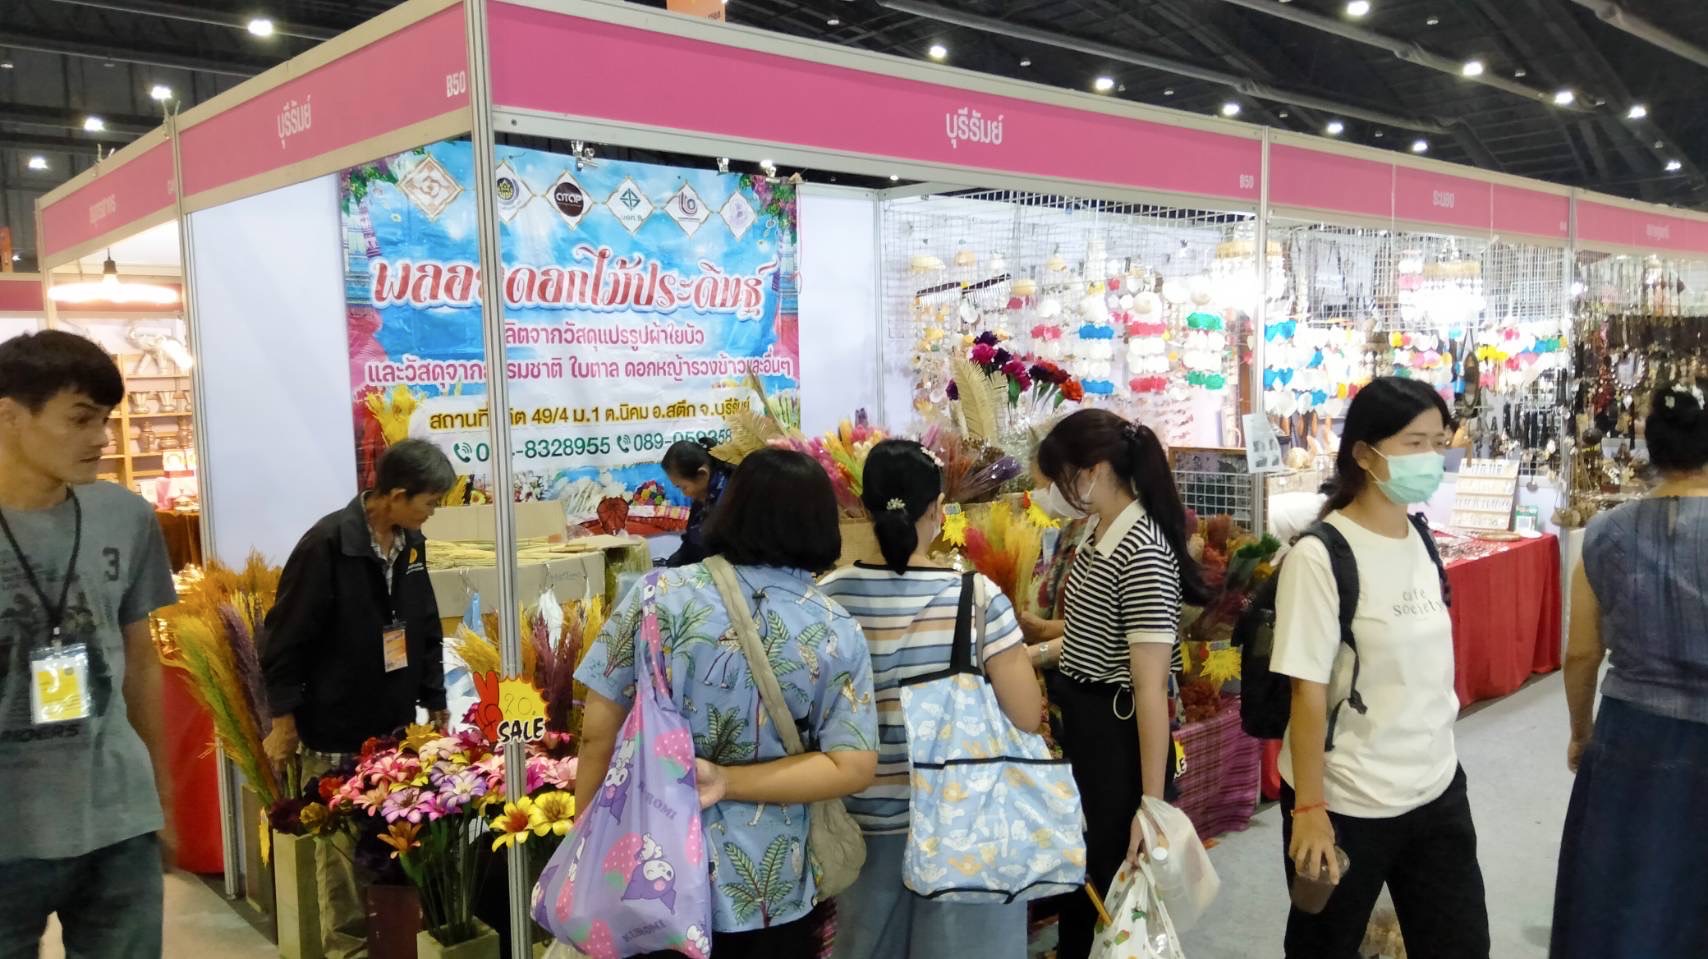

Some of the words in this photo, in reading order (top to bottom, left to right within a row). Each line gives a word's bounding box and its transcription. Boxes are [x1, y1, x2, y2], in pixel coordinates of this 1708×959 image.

[446, 71, 466, 98] B50
[277, 95, 312, 150] บุรีรัมย์
[945, 106, 1004, 149] บุรีรัมย์
[374, 246, 778, 317] พลอดอกไม้ประดิษฐ์
[504, 322, 705, 350] ลิตจากวัสดุแปรรูปผ้าใยบัว
[368, 356, 563, 388] และวัสดุจากรมชาติ
[571, 355, 620, 379] ใบตาล
[532, 407, 568, 425] 49/4
[573, 407, 600, 423] ม.1
[605, 403, 649, 422] ต.นิคม
[653, 400, 696, 419] อ.สตึก
[476, 437, 611, 463] 0-8328955
[102, 547, 120, 581] 3
[499, 717, 544, 743] SALE
